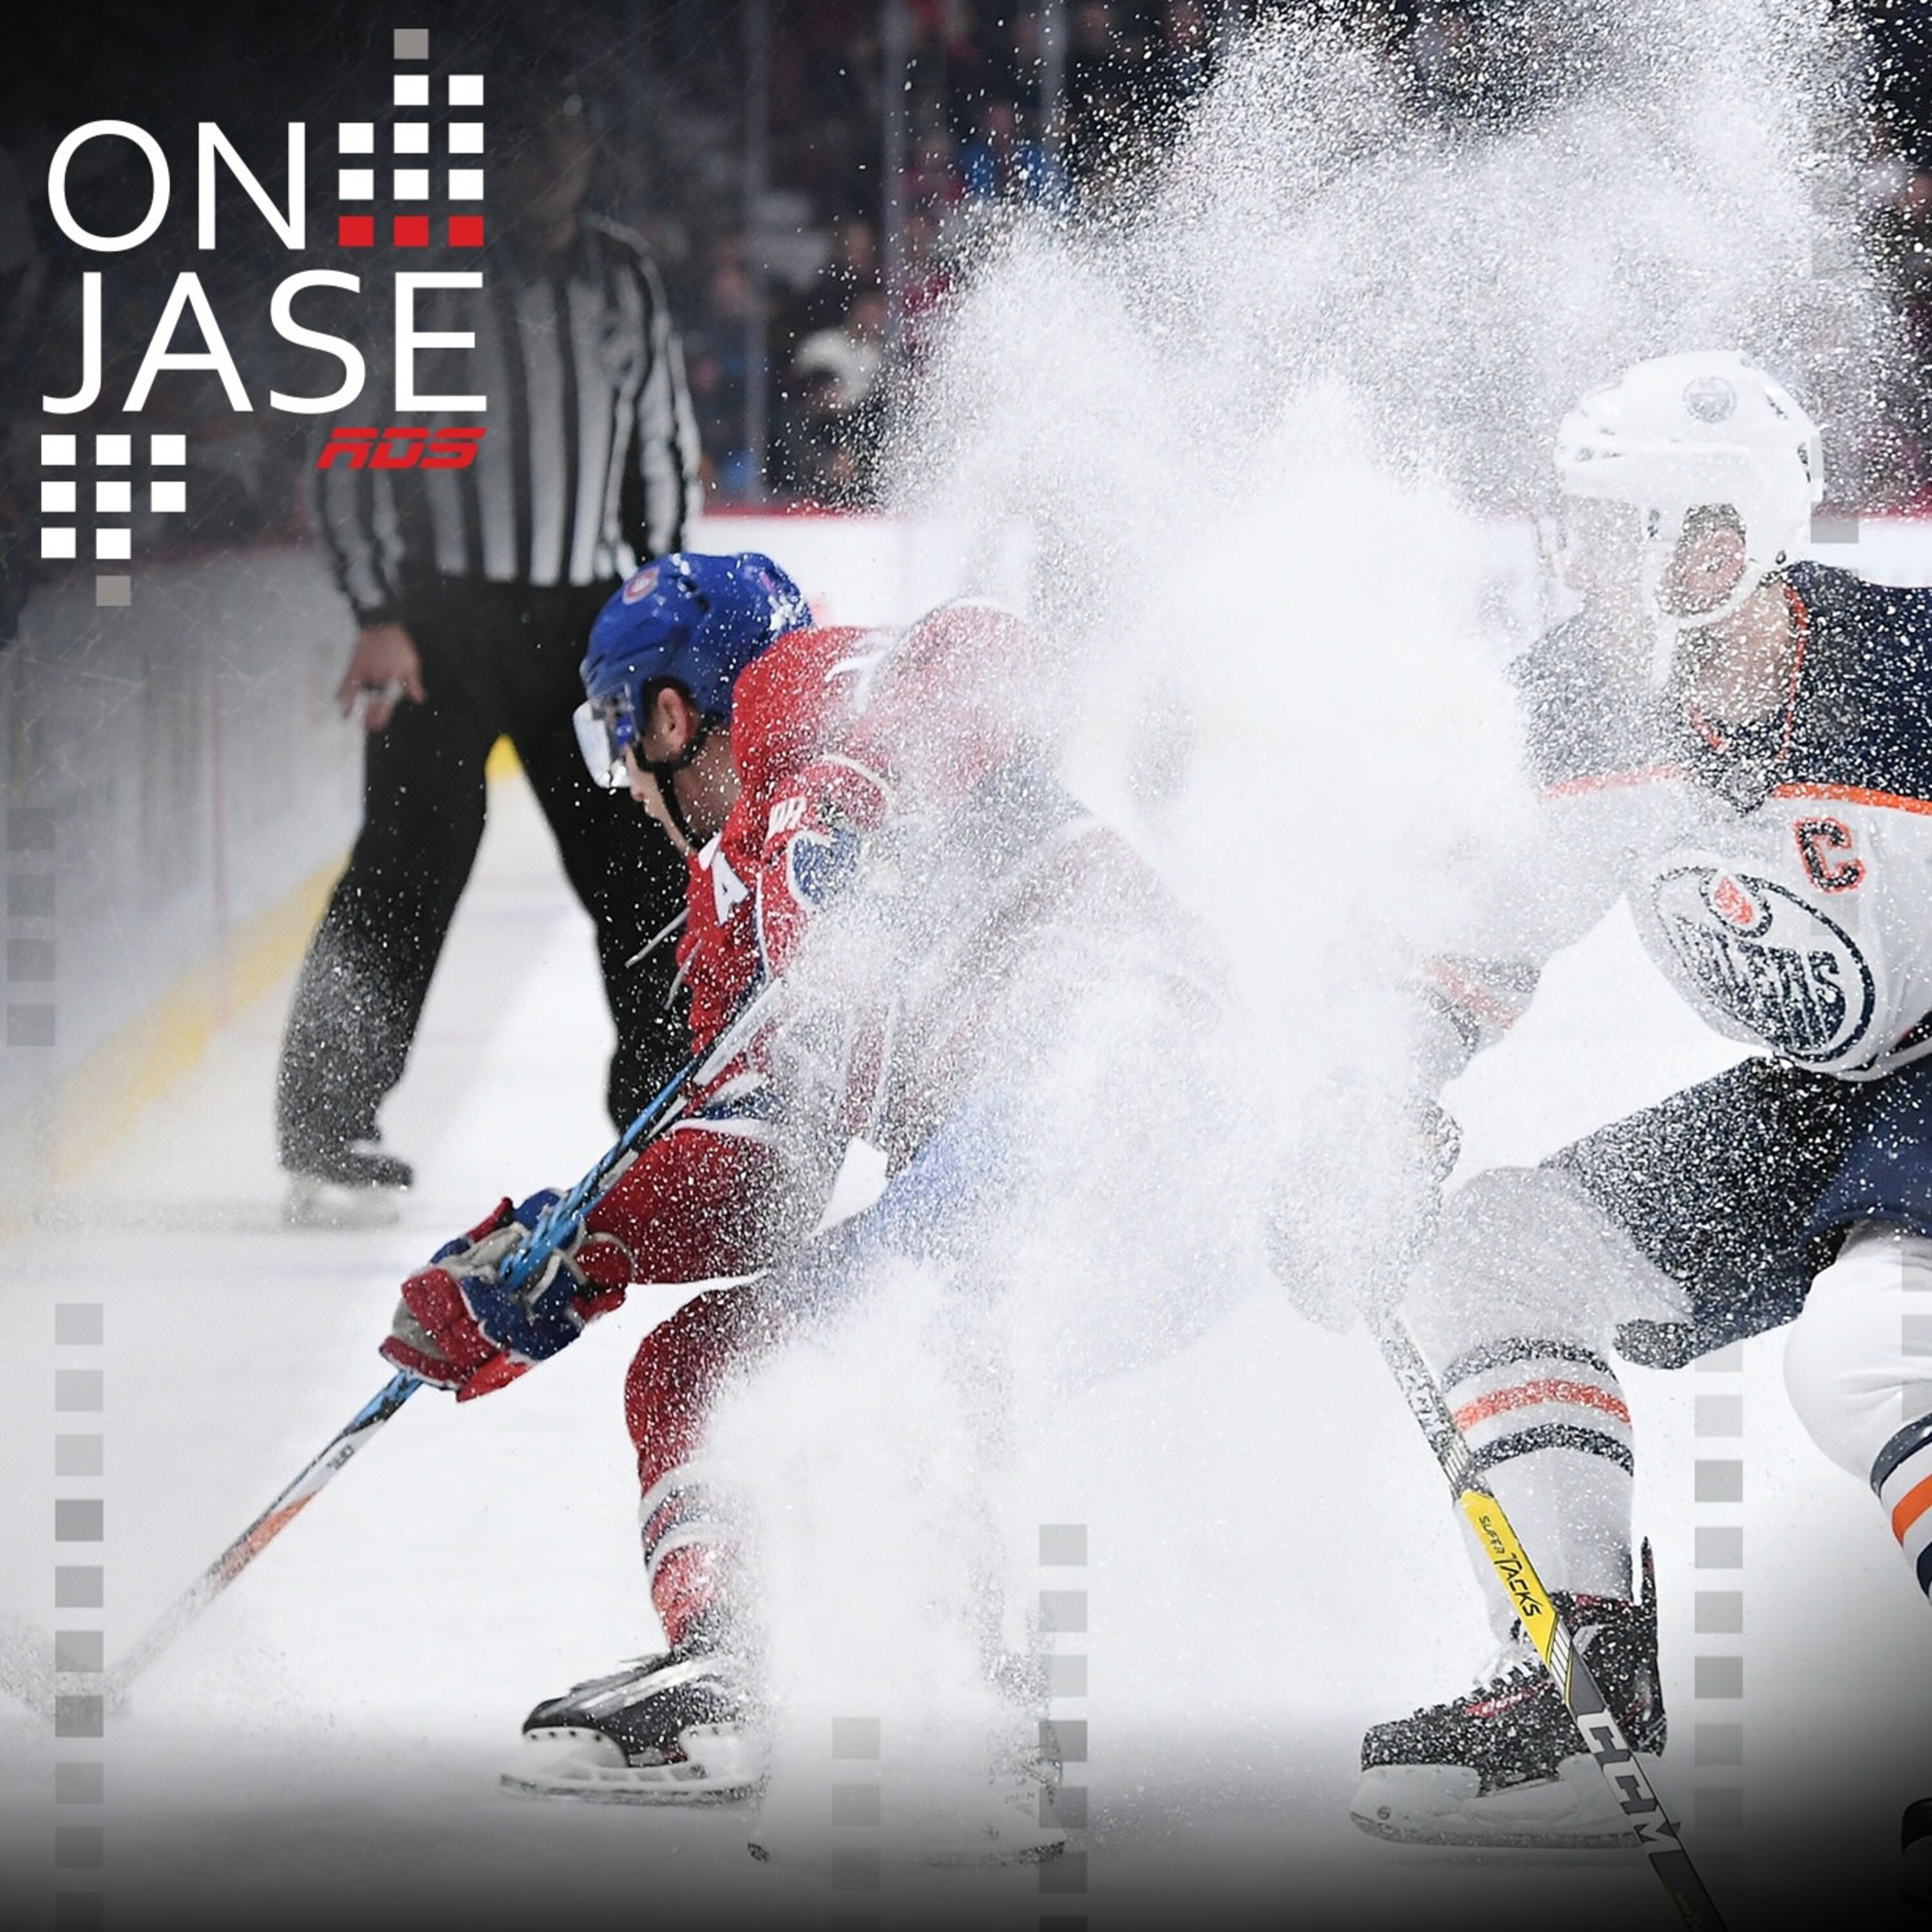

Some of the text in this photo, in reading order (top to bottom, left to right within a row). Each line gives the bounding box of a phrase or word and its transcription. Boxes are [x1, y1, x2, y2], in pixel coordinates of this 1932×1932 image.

[711, 850, 750, 927] A
[1794, 817, 1866, 894] C
[1493, 1552, 1544, 1617] TACKS
[1577, 1706, 1684, 1853] CCM
